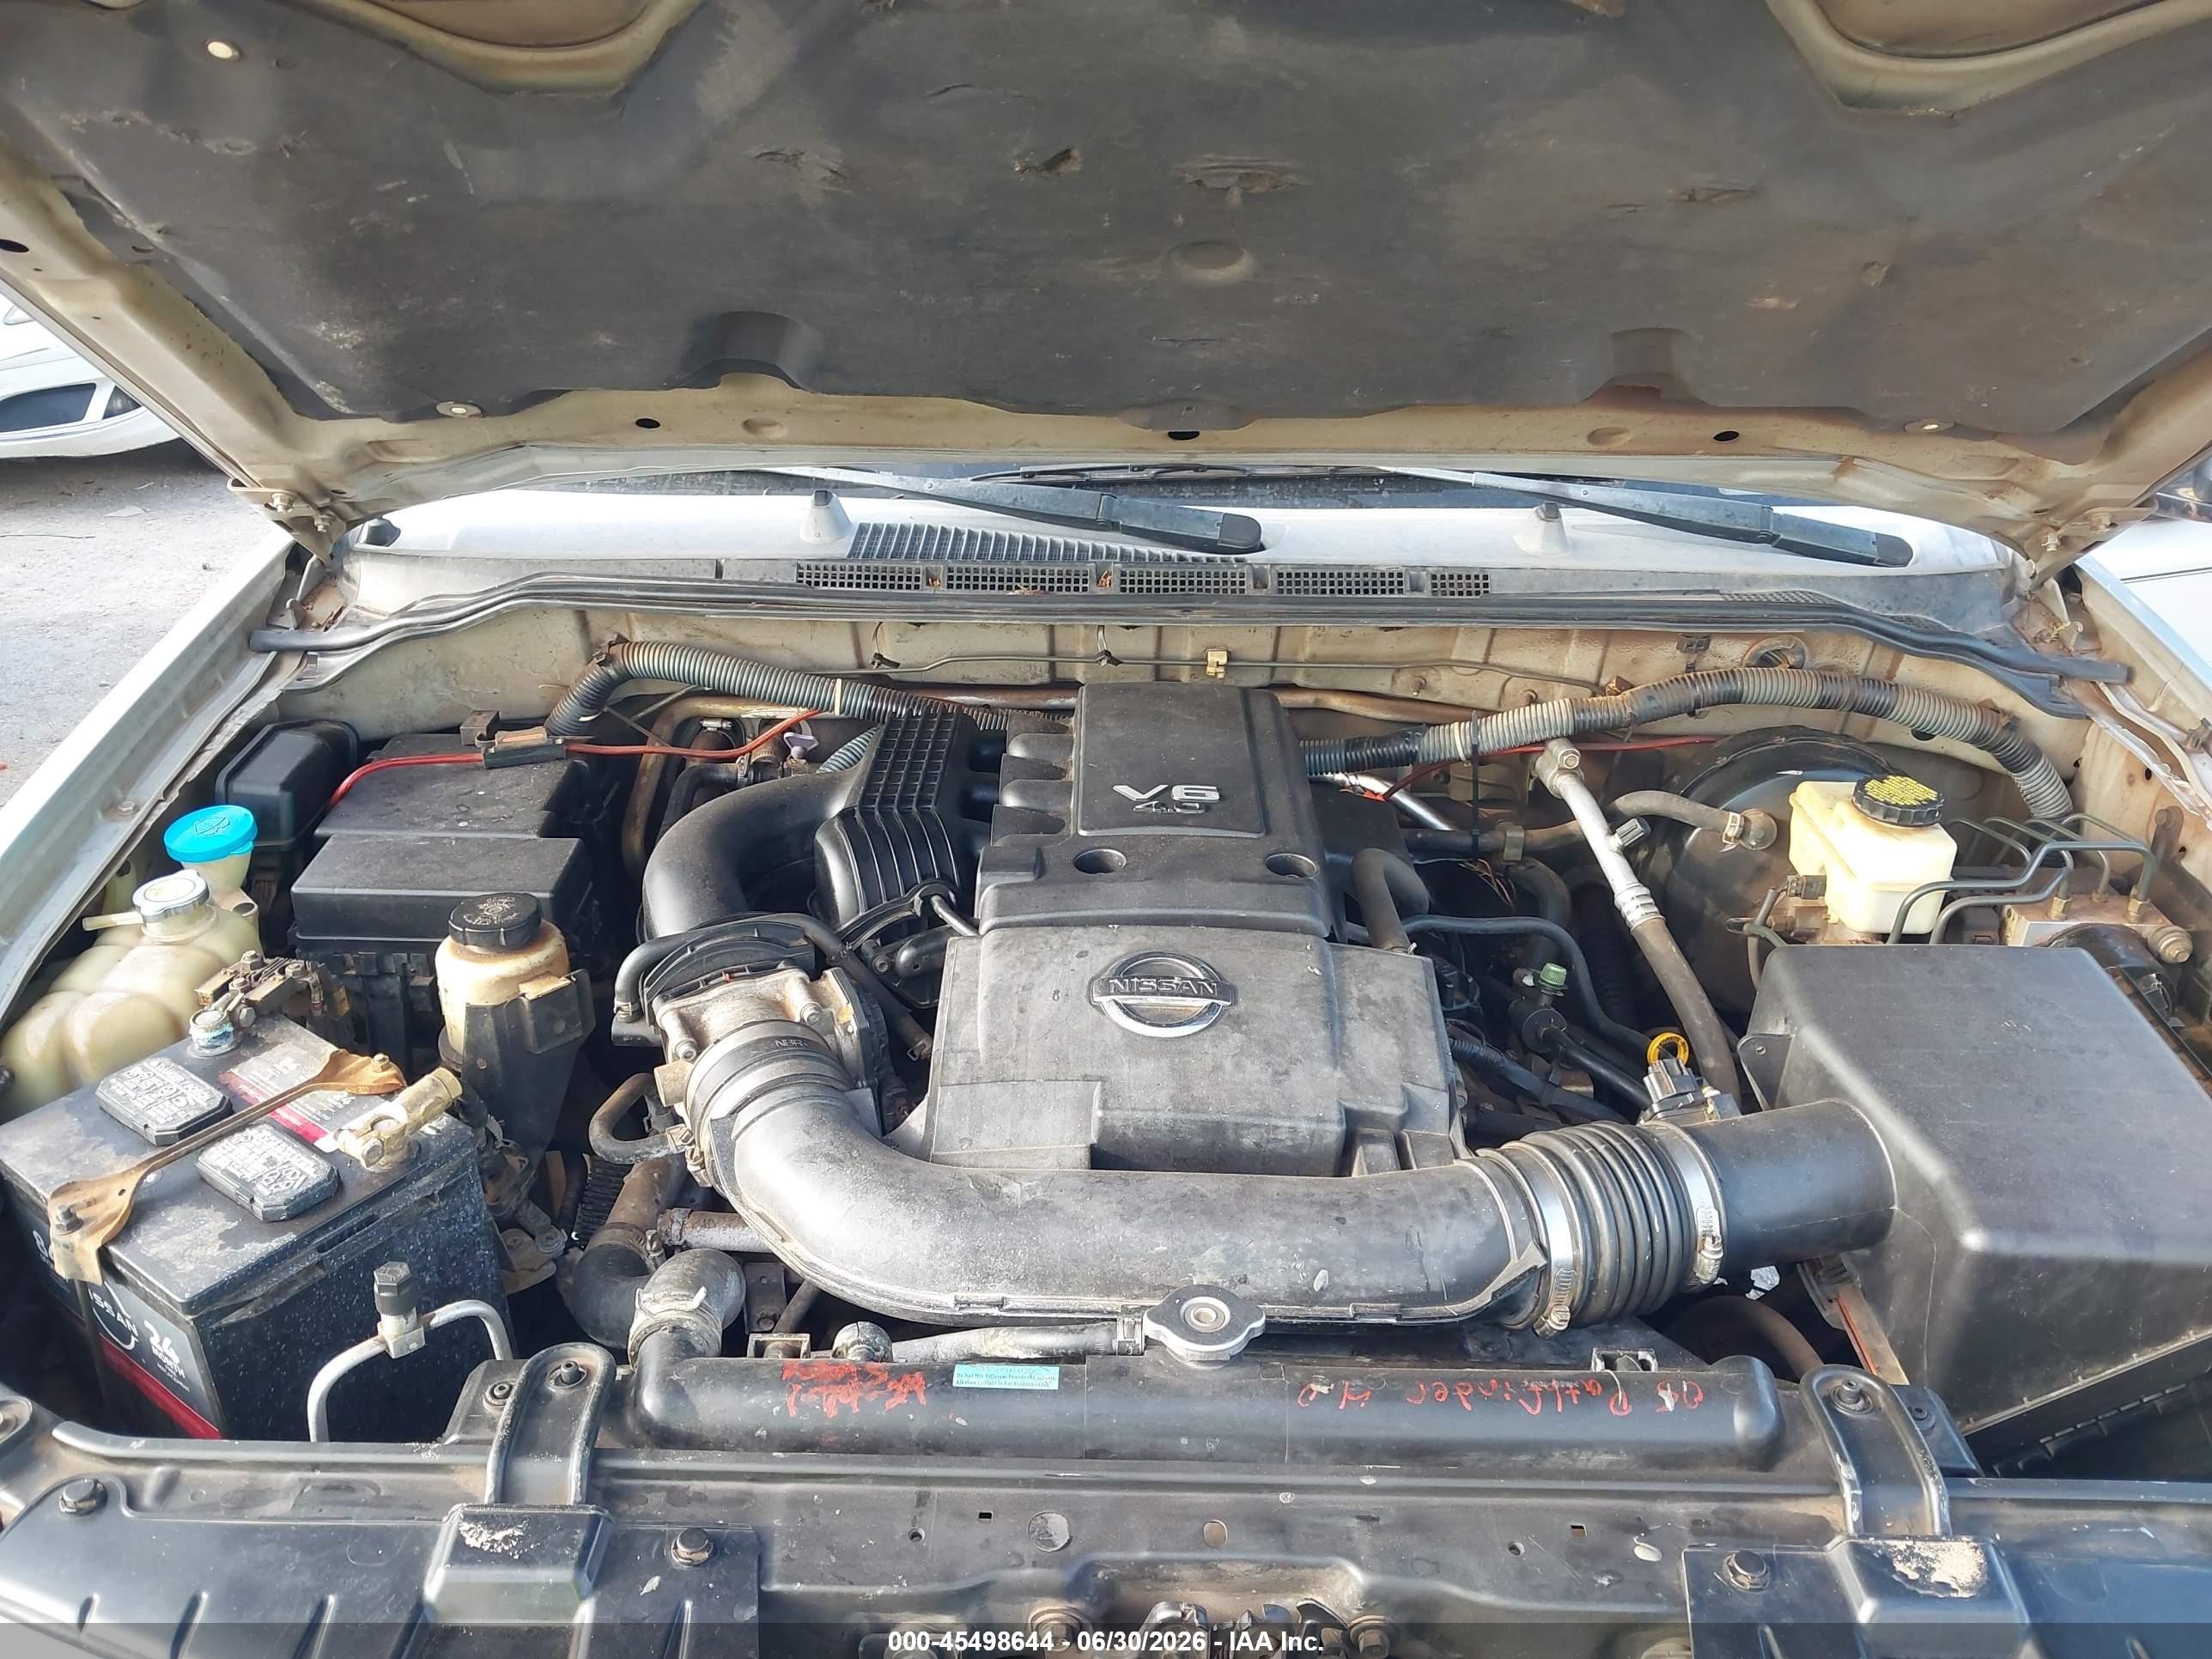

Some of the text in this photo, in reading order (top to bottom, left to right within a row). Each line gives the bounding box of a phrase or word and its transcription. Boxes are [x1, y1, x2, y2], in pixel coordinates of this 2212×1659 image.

[1113, 785, 1221, 802] V6
[1109, 978, 1218, 995] NISSAN
[1407, 1377, 1632, 1416] Pathfinder
